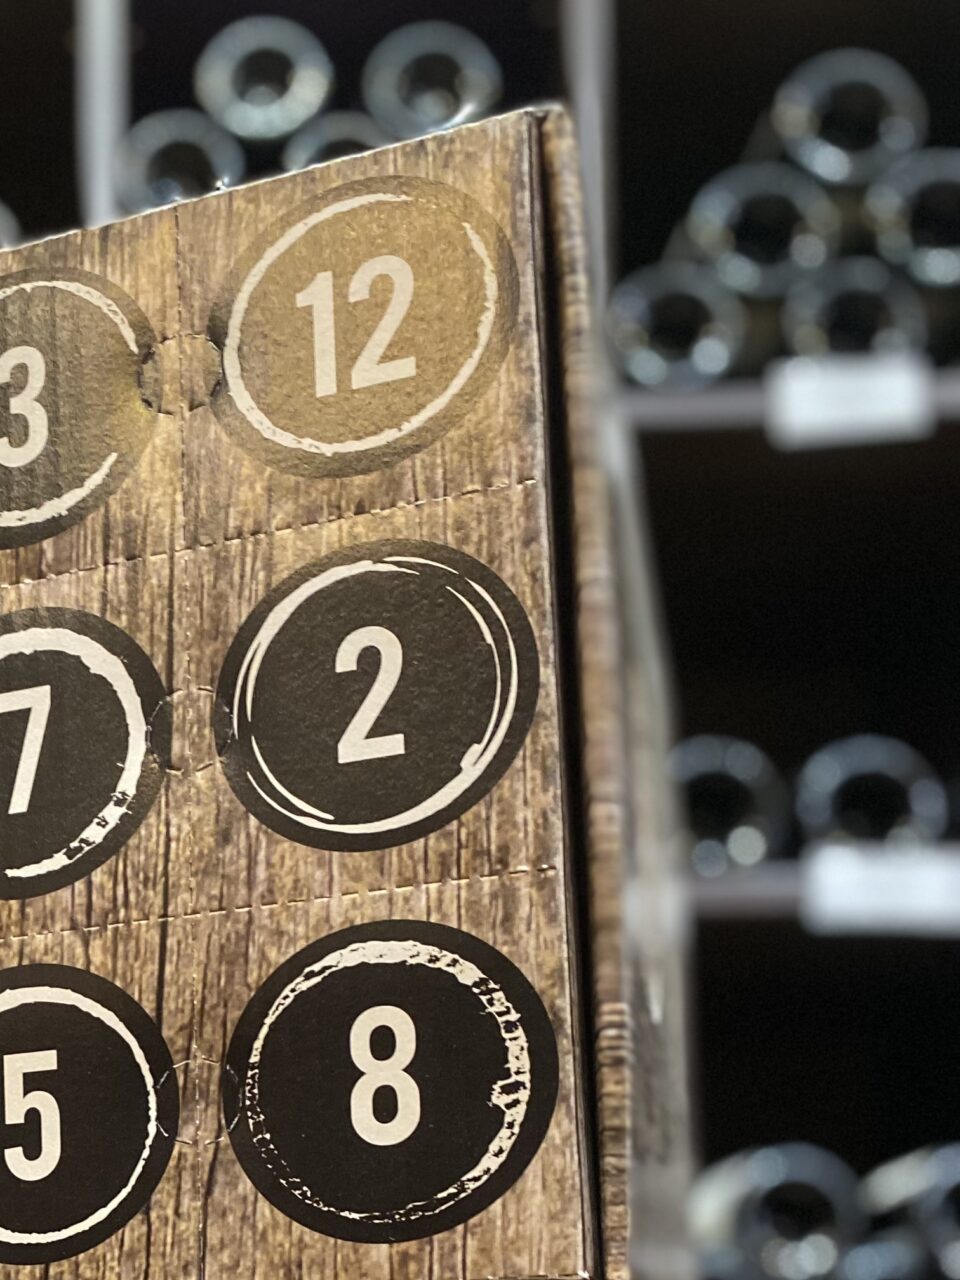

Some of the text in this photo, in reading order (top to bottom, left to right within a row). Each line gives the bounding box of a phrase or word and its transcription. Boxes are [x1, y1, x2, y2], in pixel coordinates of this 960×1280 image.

[295, 254, 417, 399] 12
[334, 626, 406, 764] 2
[3, 1049, 62, 1182] 5
[349, 1005, 421, 1146] 8
